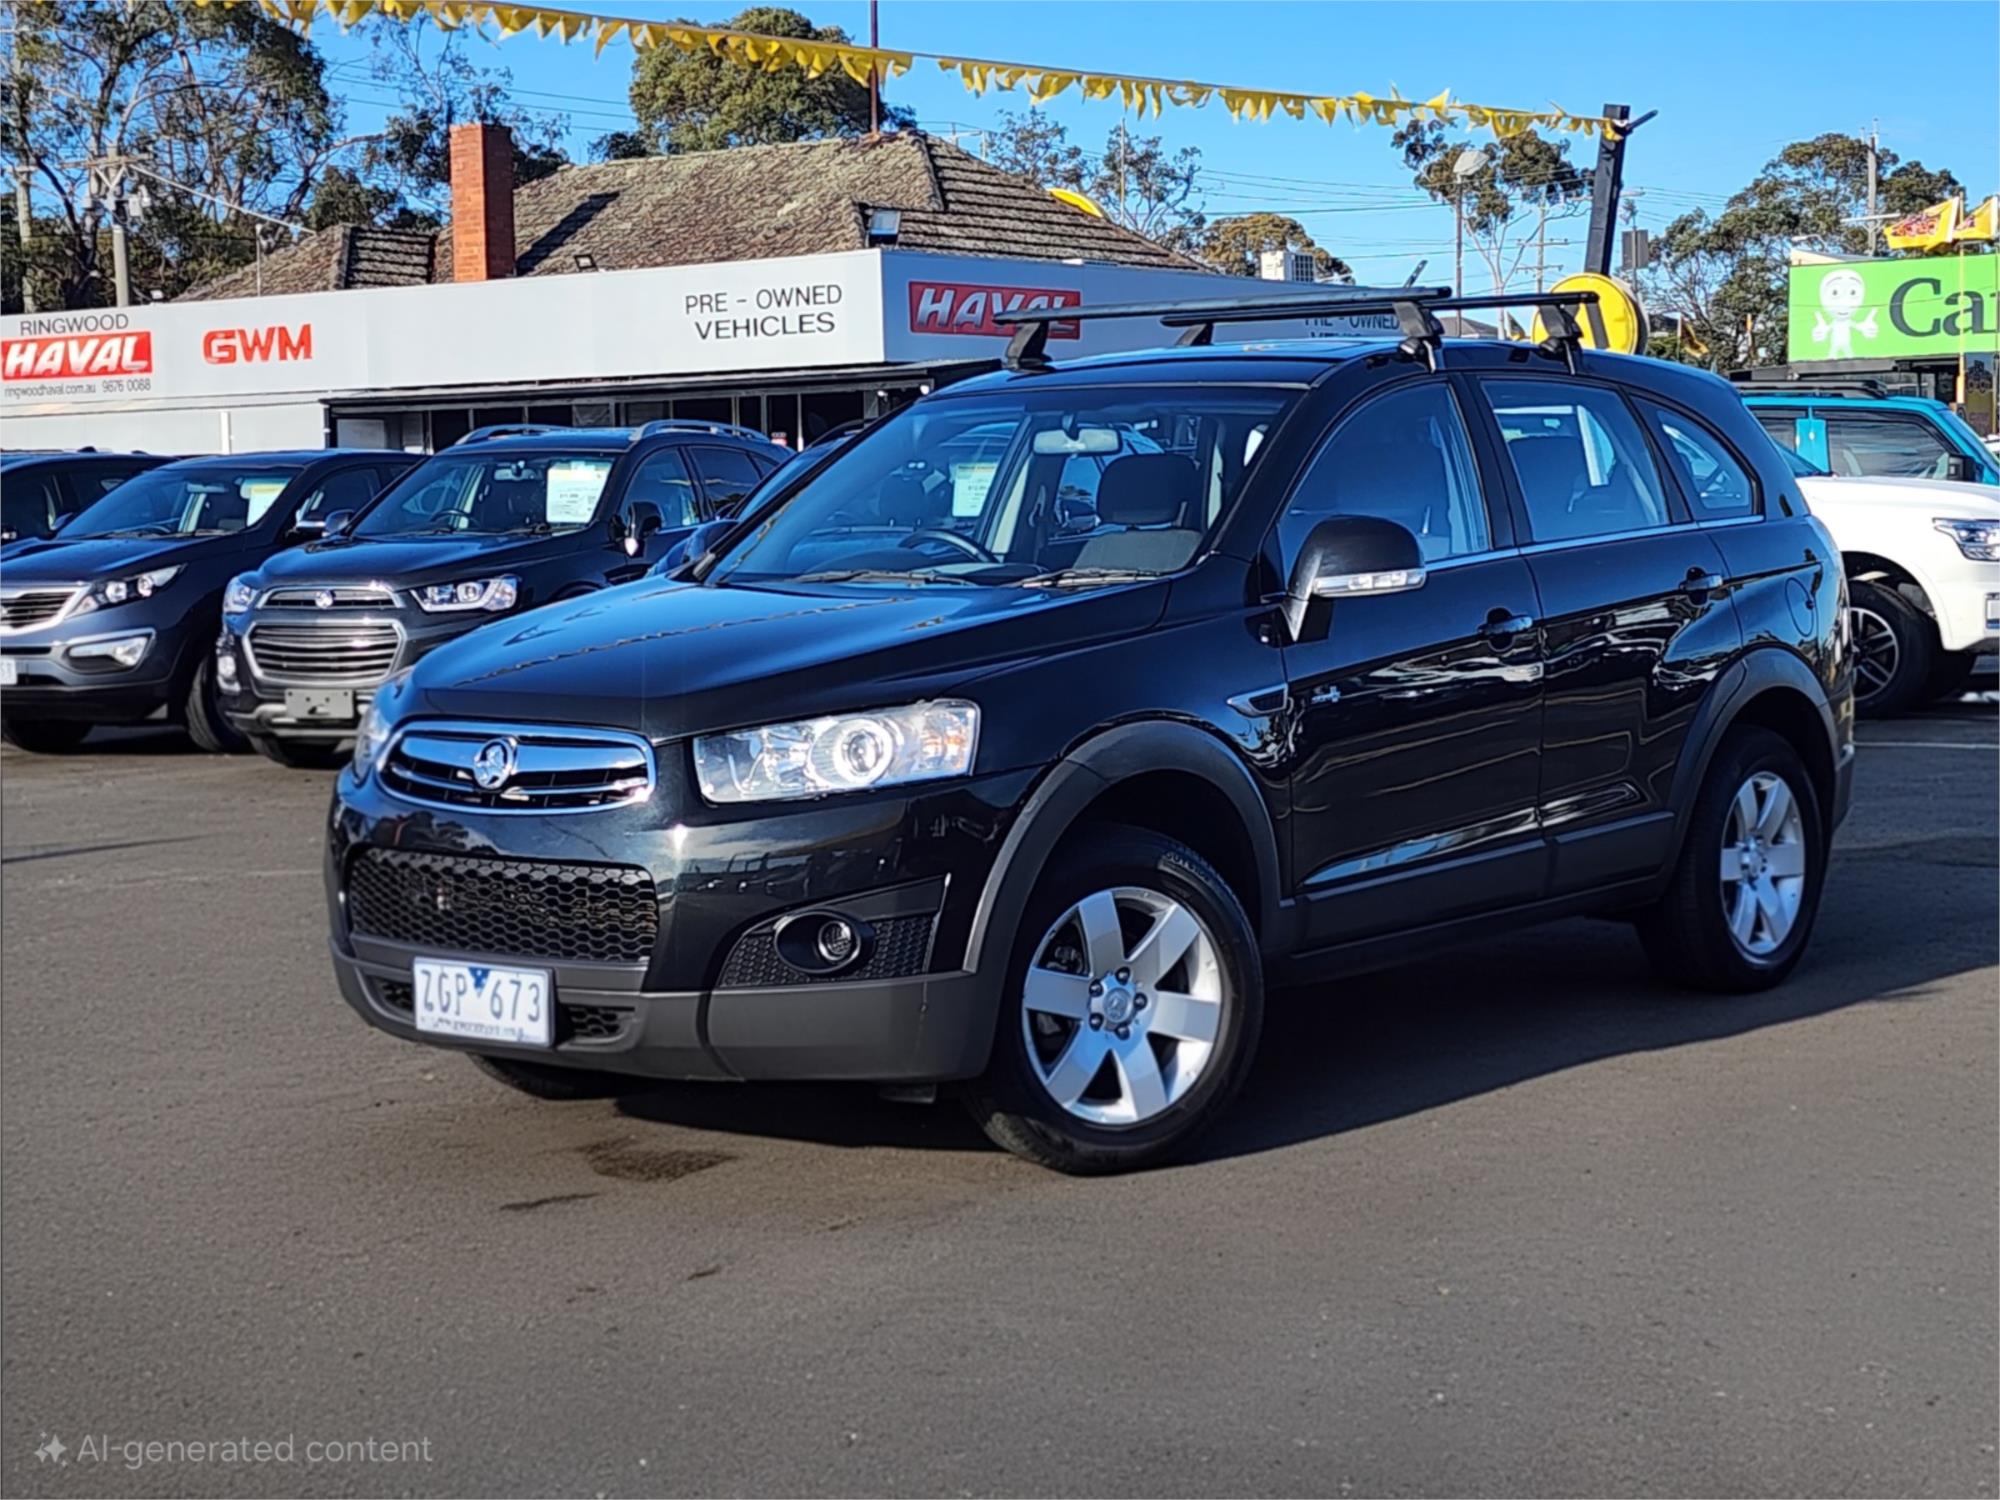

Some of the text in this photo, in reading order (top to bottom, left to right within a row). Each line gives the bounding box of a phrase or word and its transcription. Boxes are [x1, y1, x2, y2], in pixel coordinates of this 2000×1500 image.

[685, 292, 728, 315] PRE
[755, 284, 843, 310] OWNED
[1889, 277, 2000, 337] Ca
[20, 313, 129, 336] RINGWOOD
[203, 323, 313, 365] GWM
[694, 311, 836, 341] VEHICLES
[4, 336, 149, 378] HAVAL
[420, 969, 541, 1023] ZGP 673
